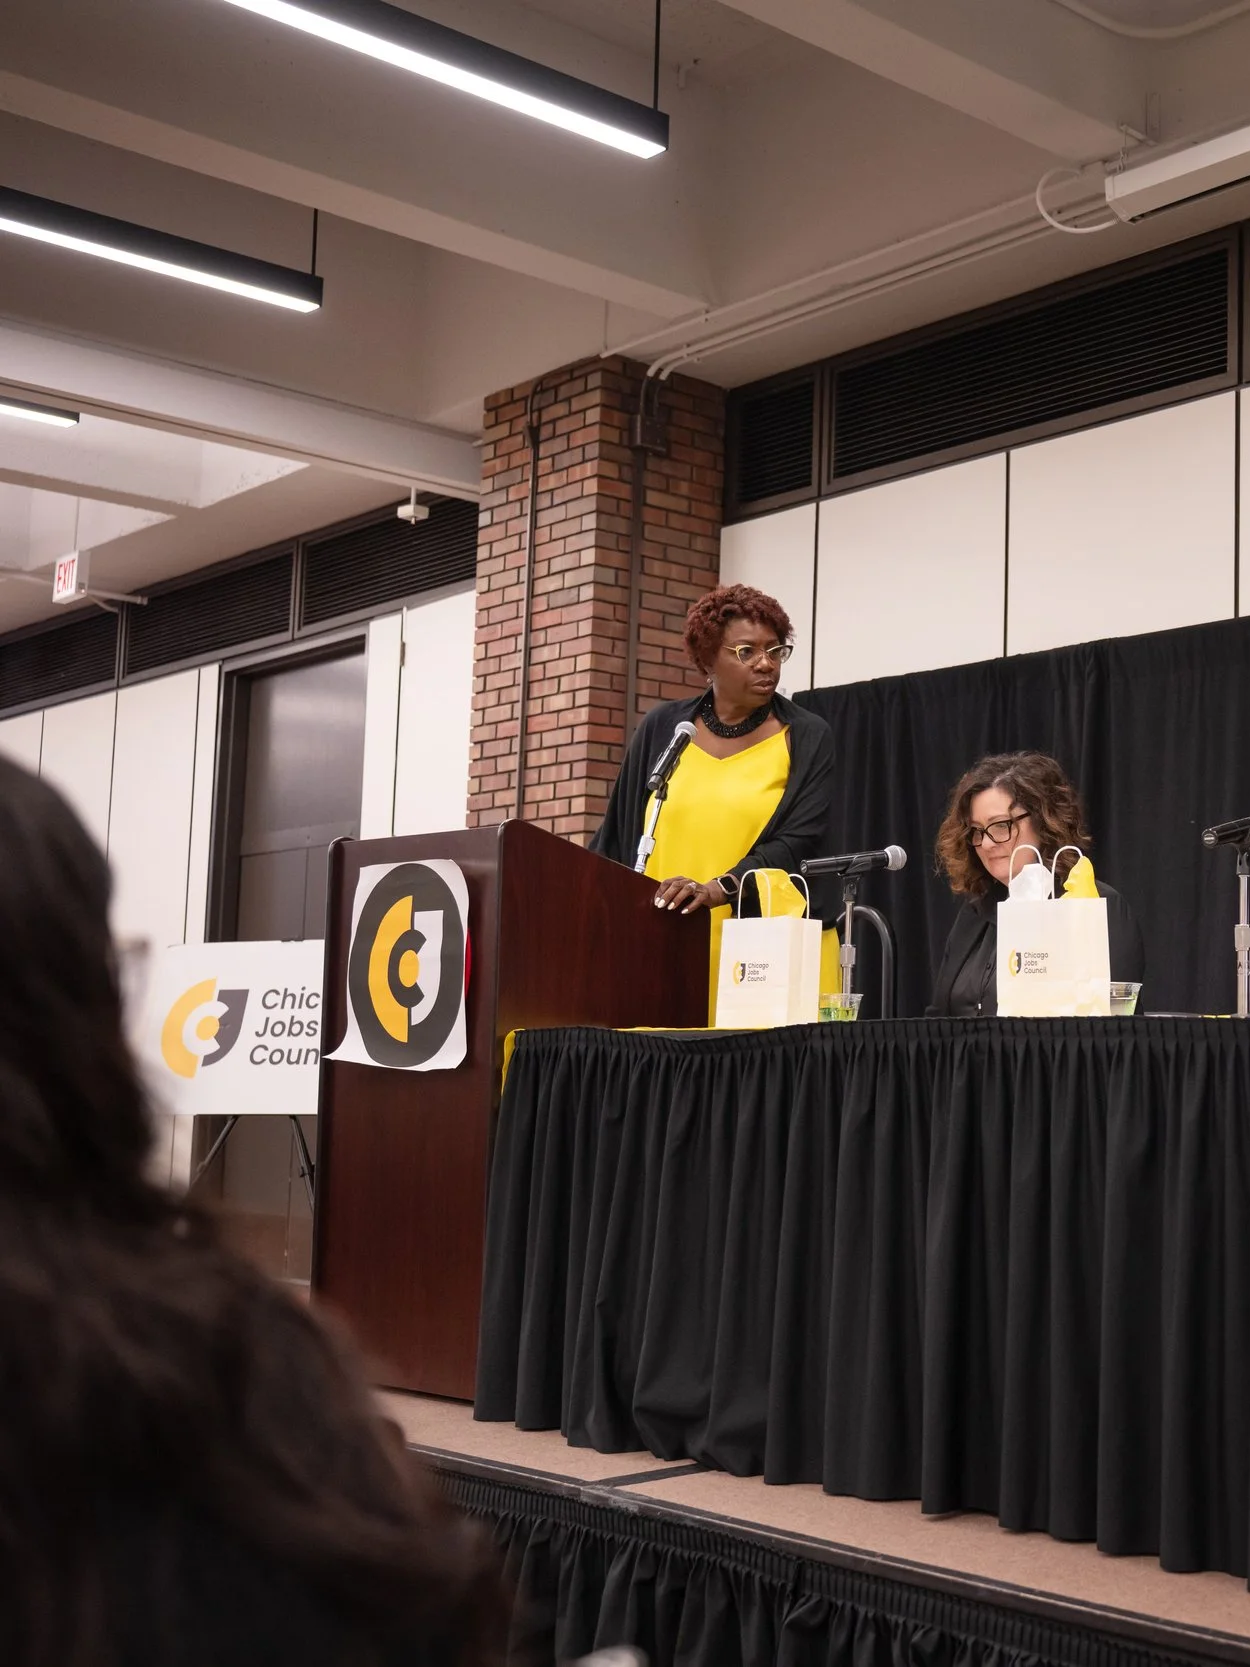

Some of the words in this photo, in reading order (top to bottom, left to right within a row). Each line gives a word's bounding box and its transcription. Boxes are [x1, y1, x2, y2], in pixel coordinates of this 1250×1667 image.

[56, 559, 76, 594] EXIT
[747, 962, 770, 971] Chicago
[1023, 952, 1049, 961] Chicago
[261, 986, 321, 1010] Chic
[254, 1015, 319, 1038] Jobs
[249, 1044, 320, 1066] Coun
